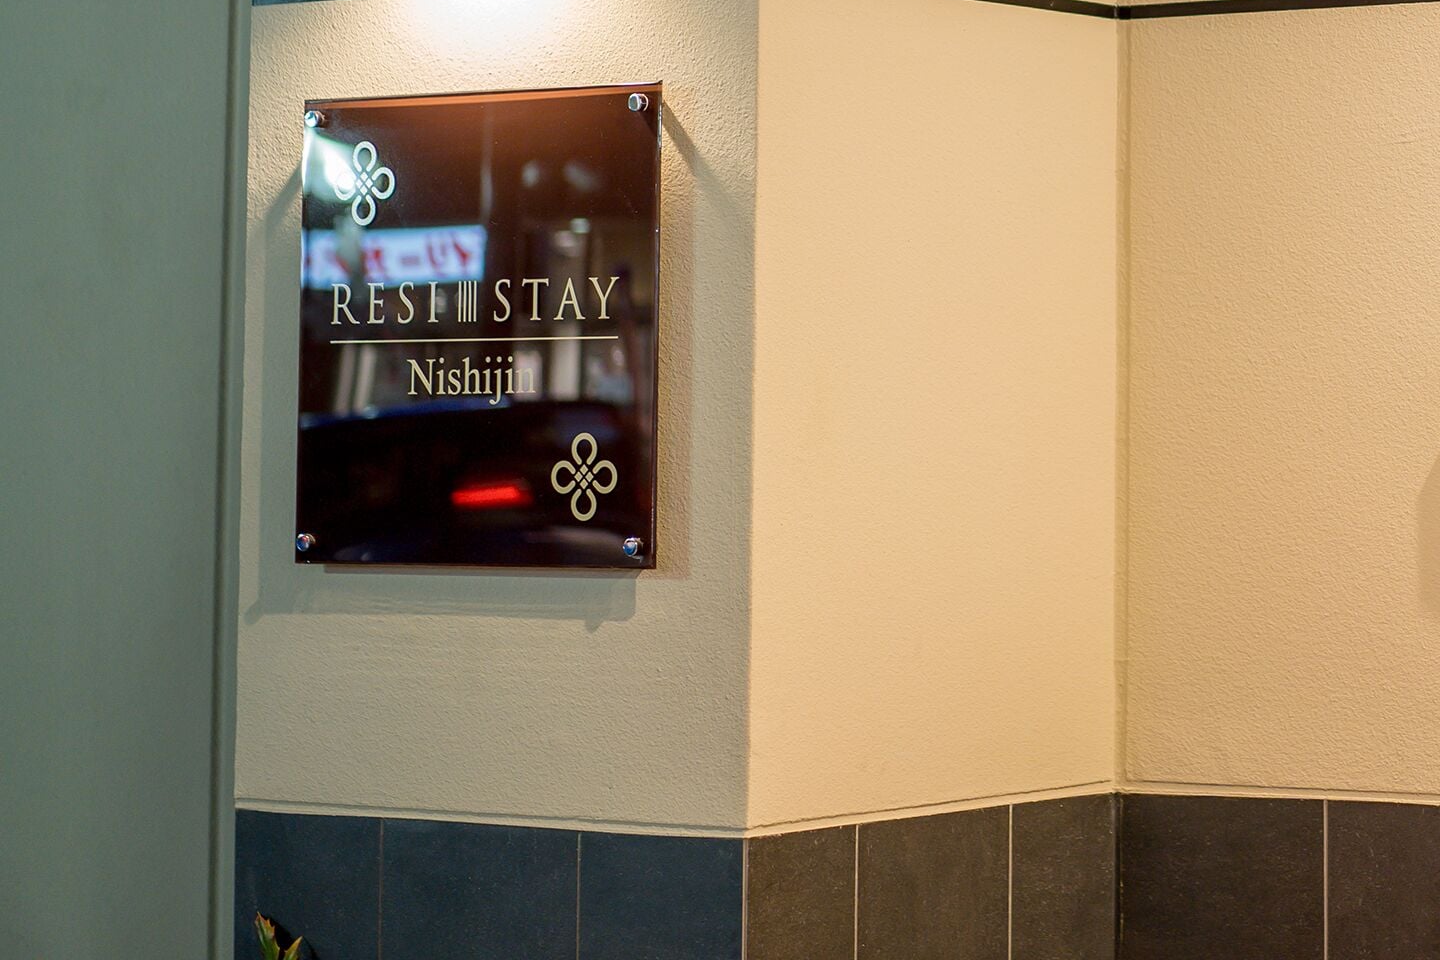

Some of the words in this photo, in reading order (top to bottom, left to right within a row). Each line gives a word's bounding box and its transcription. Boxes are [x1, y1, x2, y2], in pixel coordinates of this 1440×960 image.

[330, 280, 439, 325] RESI
[493, 276, 621, 323] STAY
[406, 356, 537, 406] Nishijin
